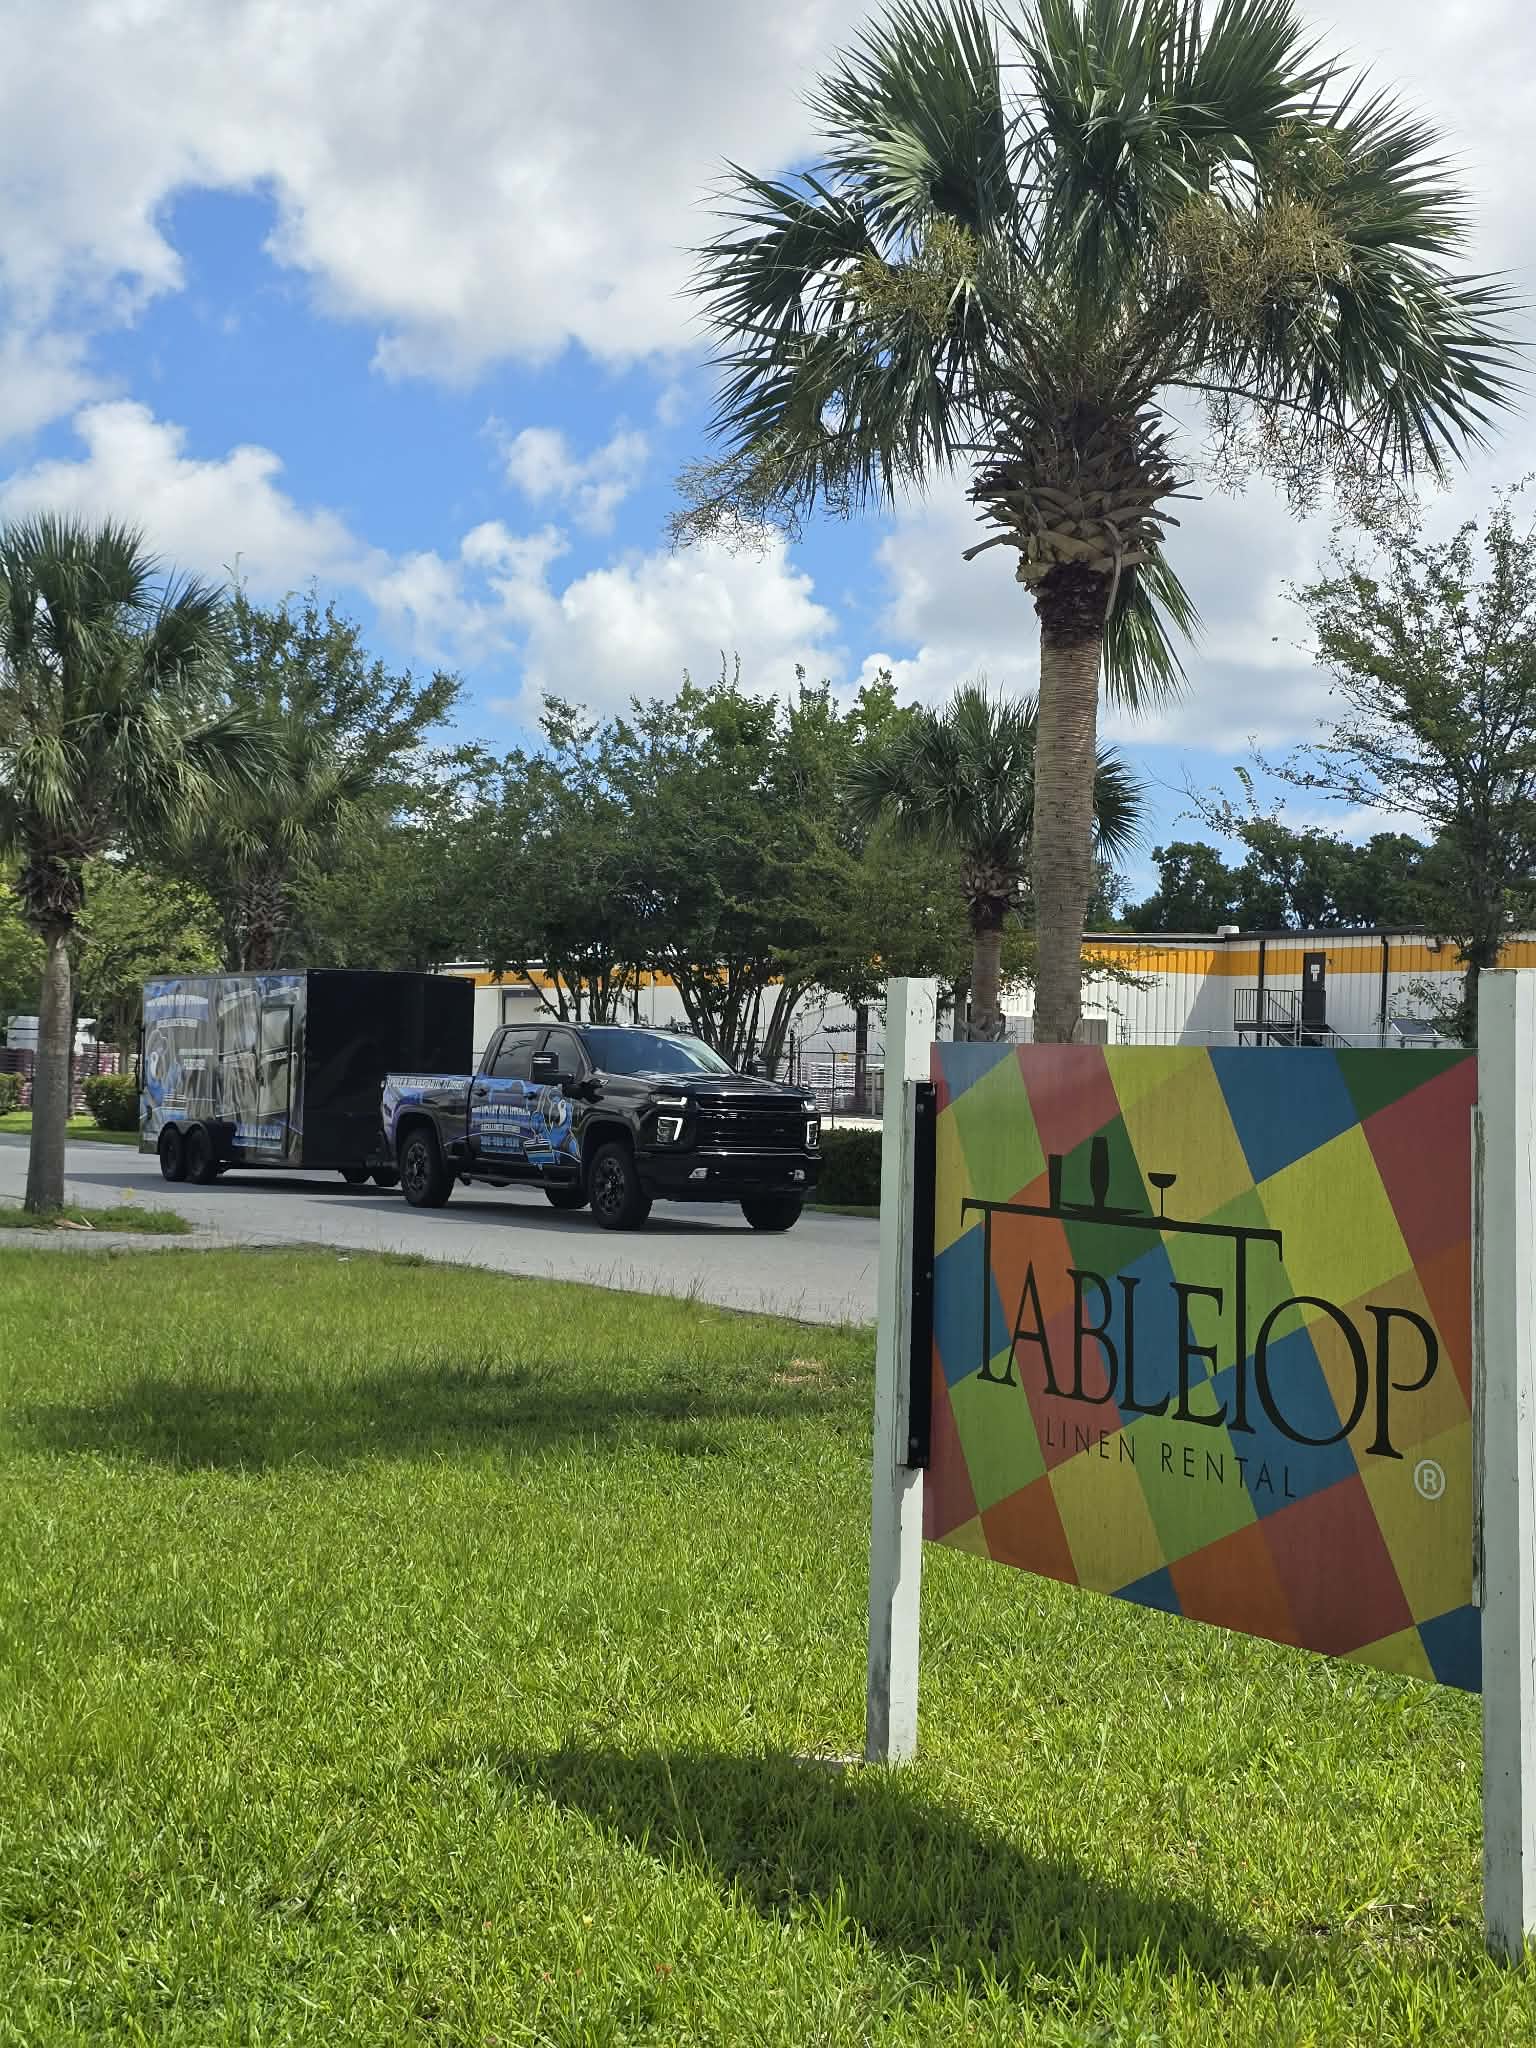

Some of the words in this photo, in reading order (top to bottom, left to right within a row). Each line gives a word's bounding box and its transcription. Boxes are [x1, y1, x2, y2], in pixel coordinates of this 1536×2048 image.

[961, 1198, 1438, 1460] TABLETOP
[1047, 1416, 1135, 1464] LINEN
[1161, 1442, 1296, 1498] RENTAL
